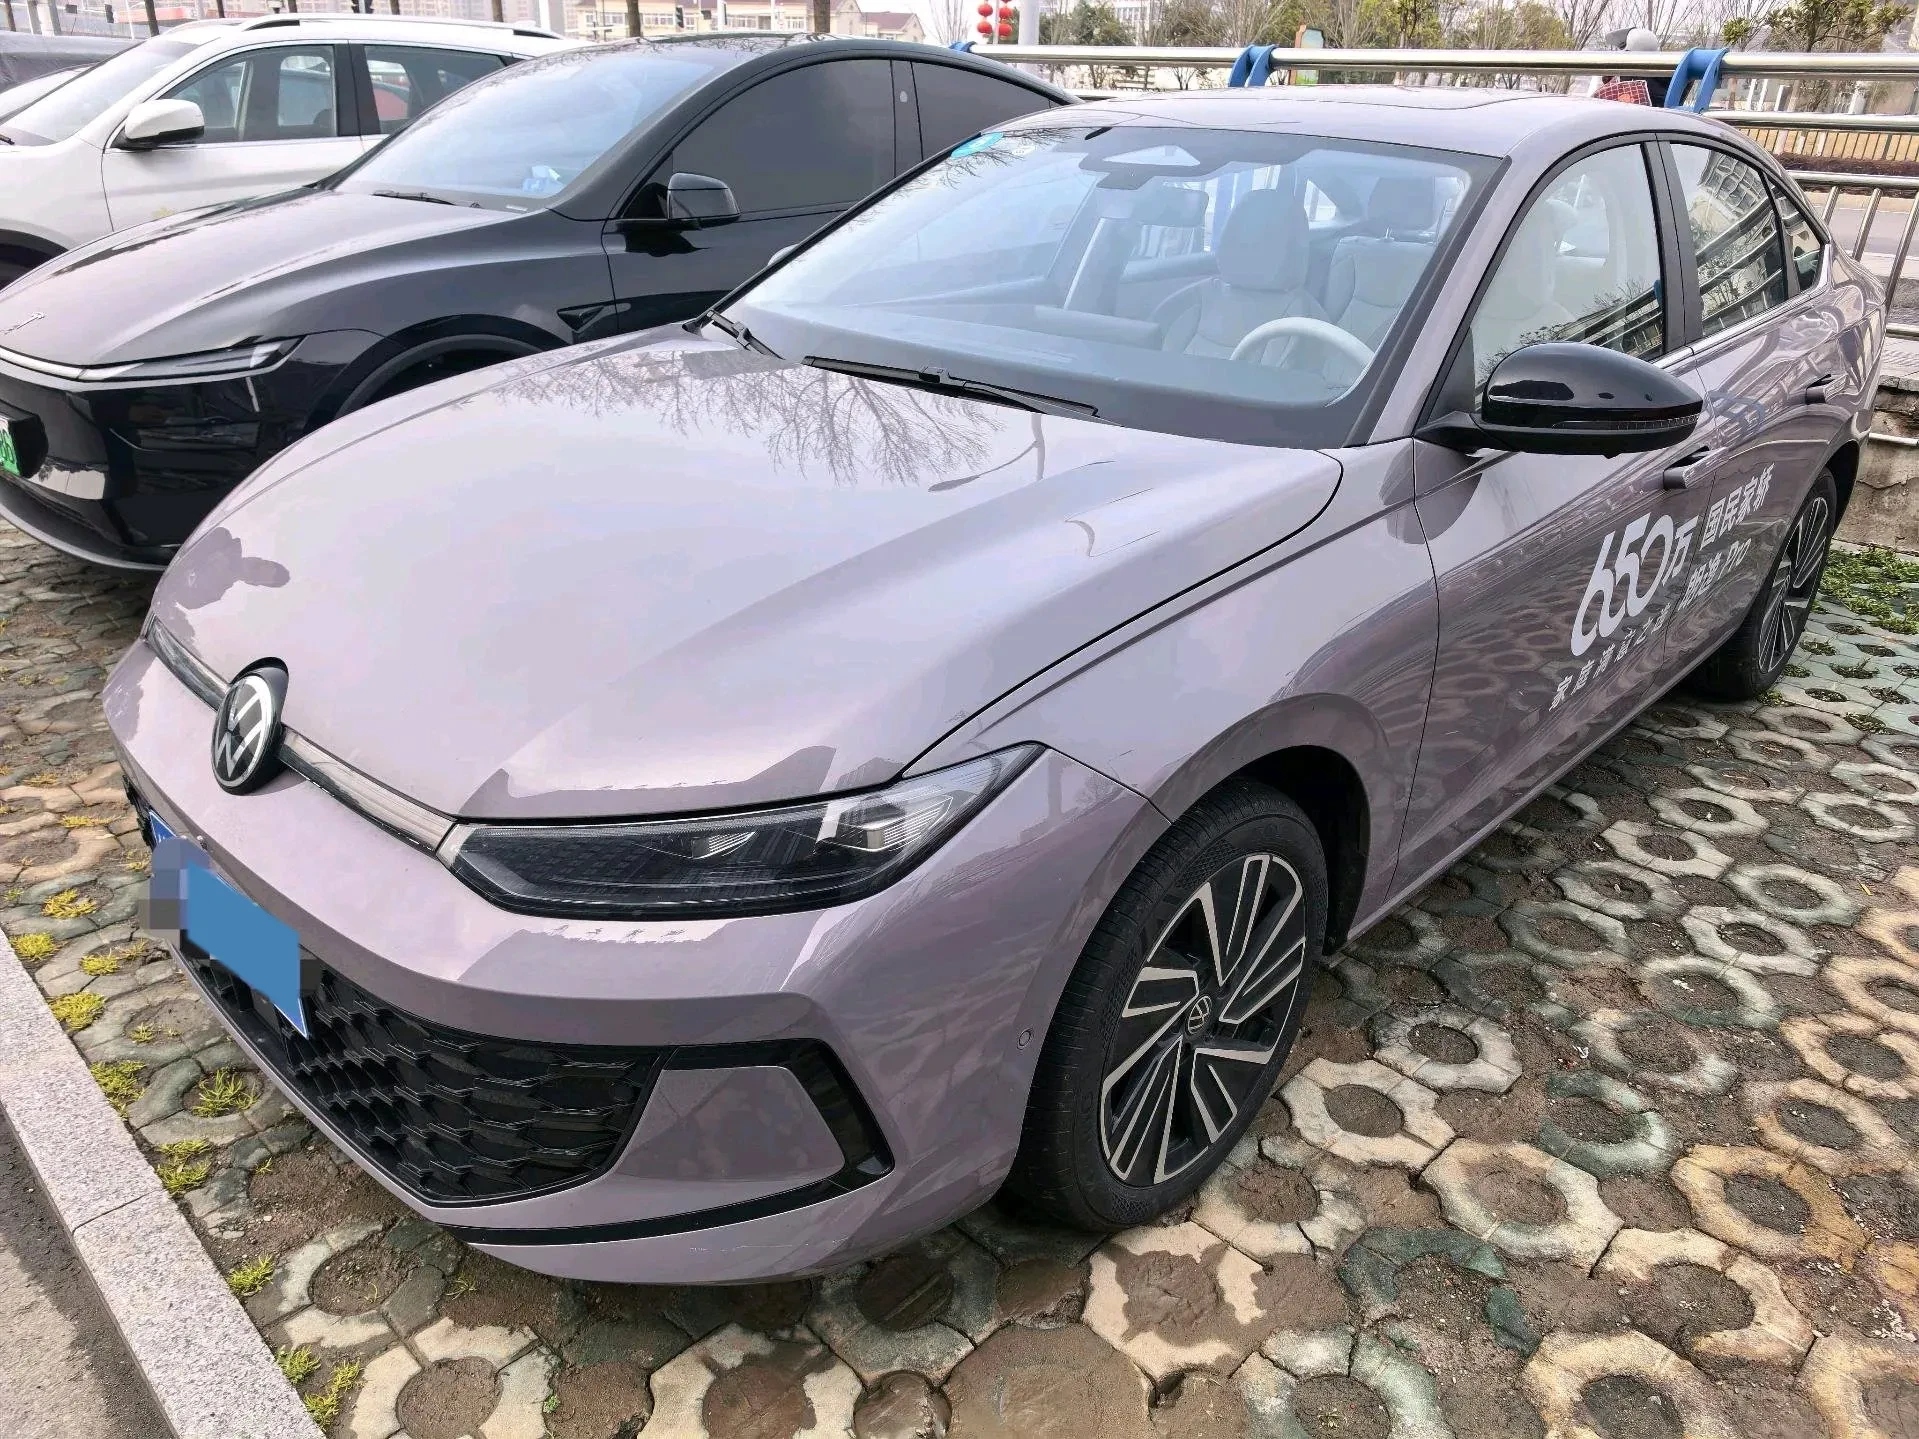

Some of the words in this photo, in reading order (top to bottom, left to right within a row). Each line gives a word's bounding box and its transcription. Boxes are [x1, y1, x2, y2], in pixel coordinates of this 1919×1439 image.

[1571, 513, 1698, 656] 650万
[1701, 463, 1774, 549] 国民家轿
[1719, 538, 1751, 577] Pro
